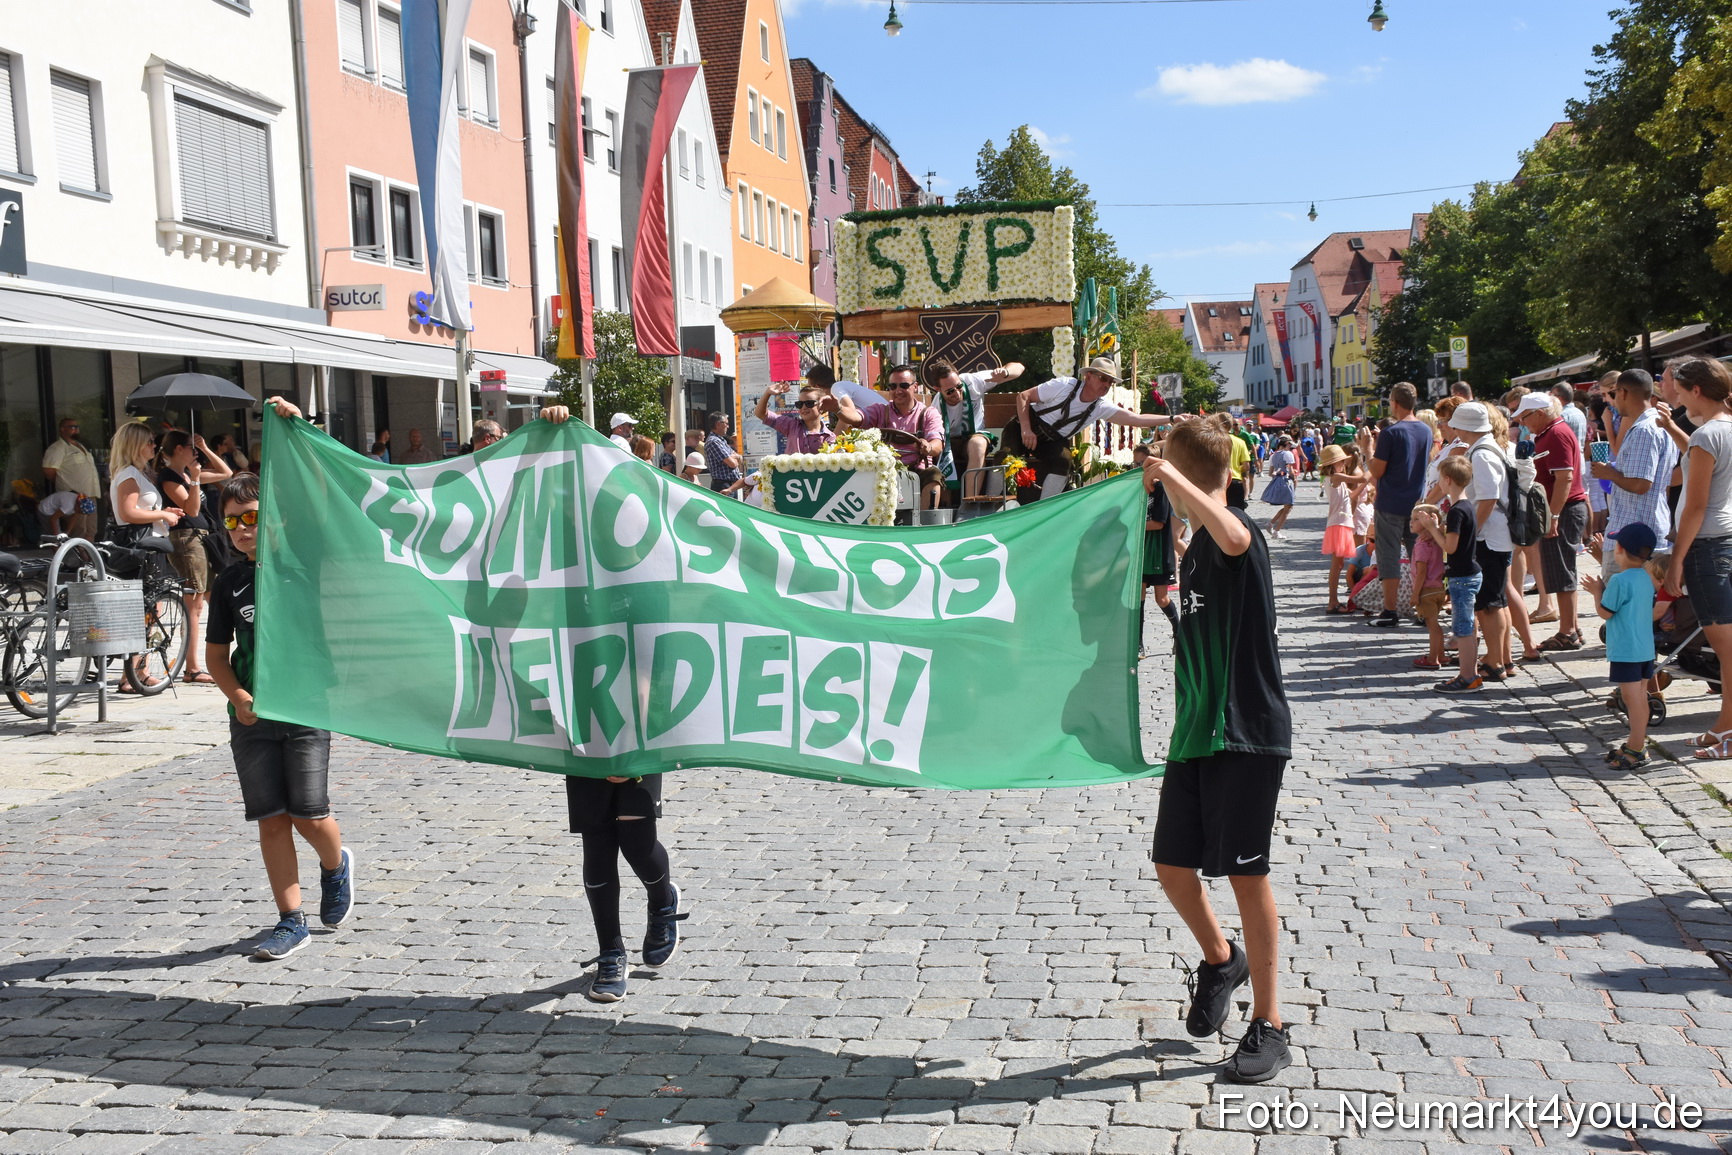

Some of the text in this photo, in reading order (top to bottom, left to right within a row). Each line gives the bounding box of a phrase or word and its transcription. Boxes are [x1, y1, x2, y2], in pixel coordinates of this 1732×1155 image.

[866, 217, 1036, 299] SVP
[934, 321, 955, 335] SV
[785, 478, 823, 503] SV
[366, 460, 1001, 616] SOMOS LOS
